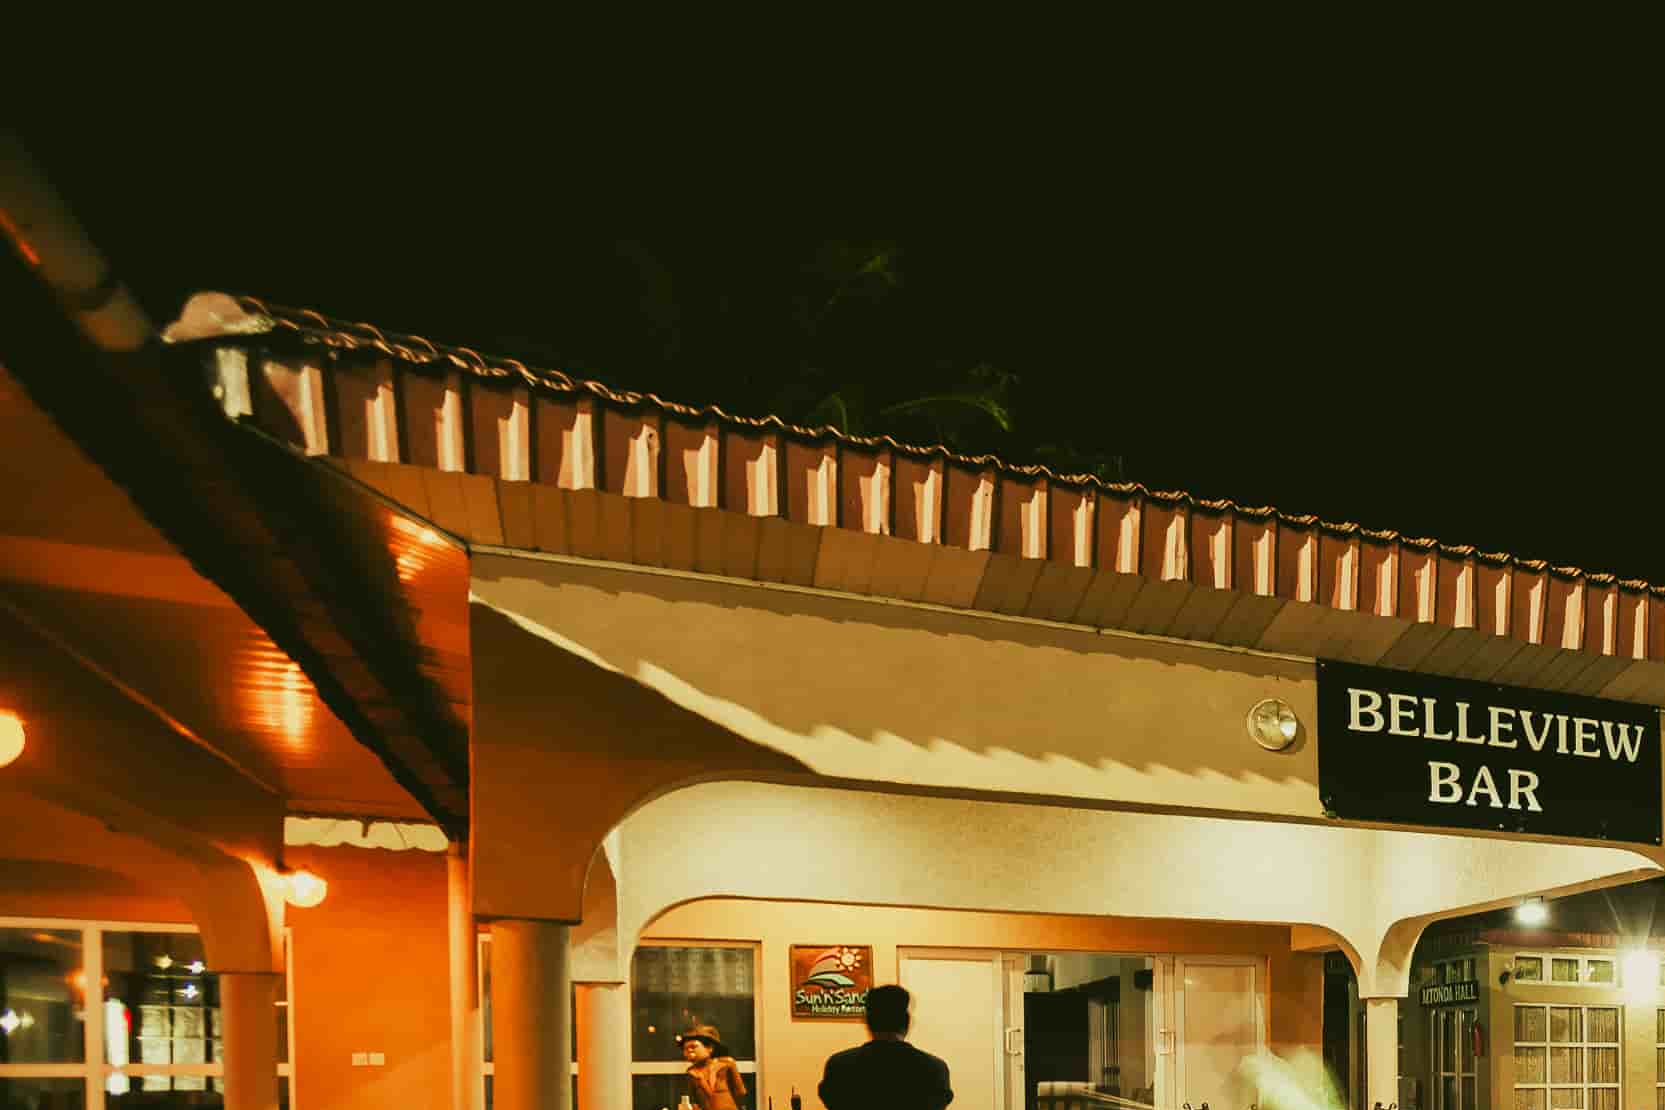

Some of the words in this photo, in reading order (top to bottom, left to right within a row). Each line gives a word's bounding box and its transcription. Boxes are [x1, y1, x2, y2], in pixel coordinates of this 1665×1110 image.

[1347, 687, 1645, 762] BELLEVIEW
[1428, 761, 1543, 812] BAR
[1455, 983, 1477, 1000] HALL
